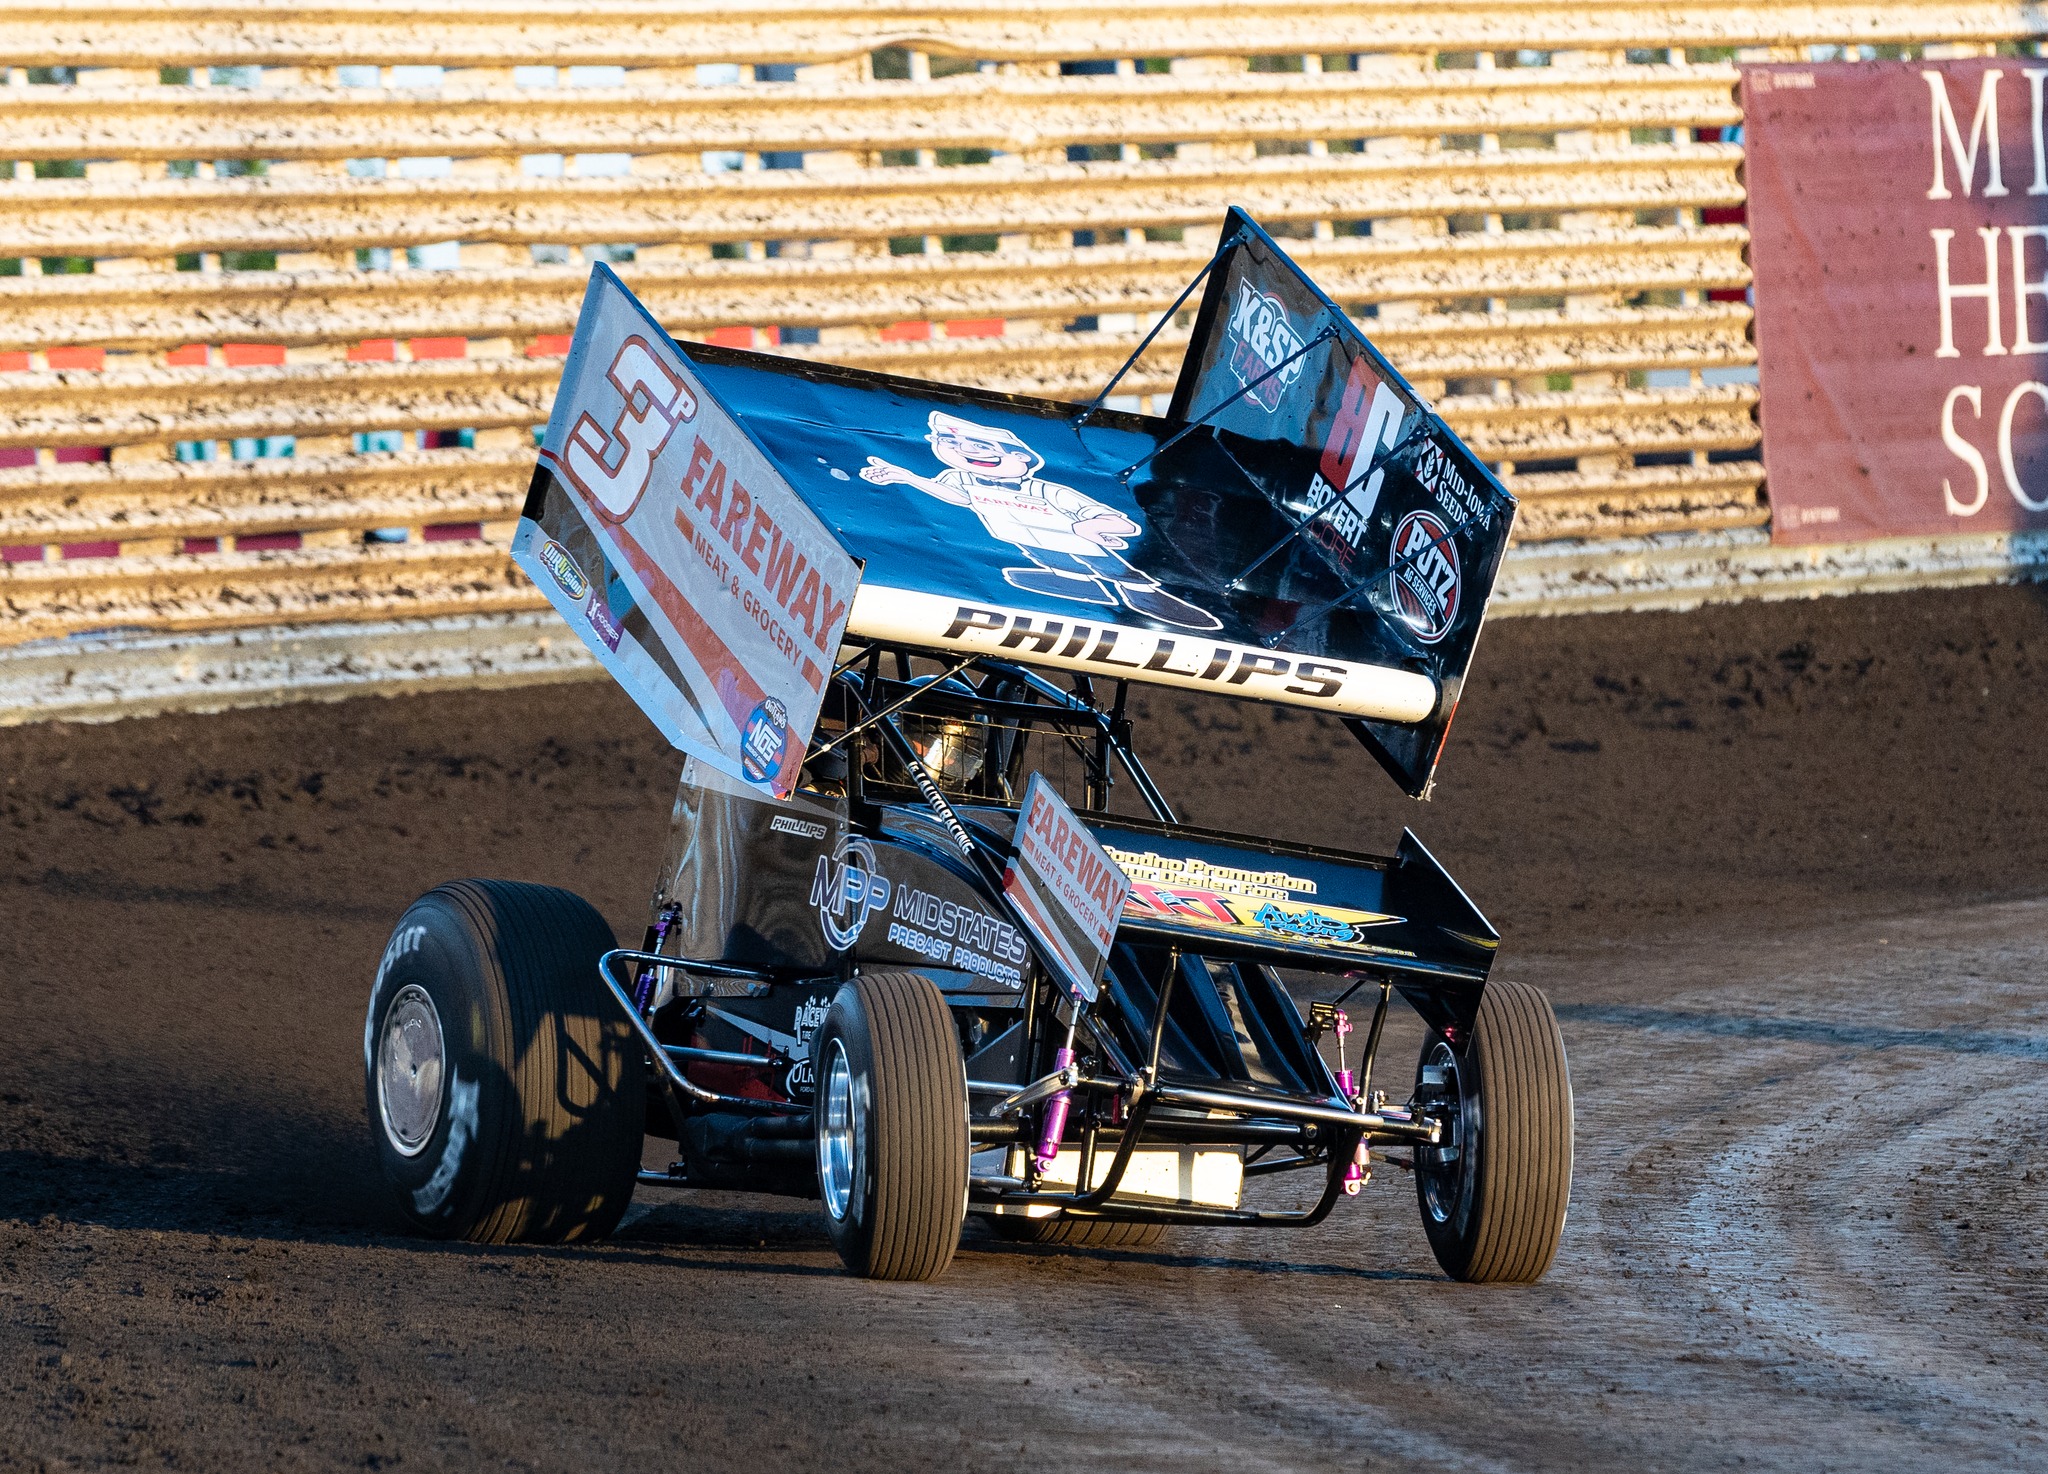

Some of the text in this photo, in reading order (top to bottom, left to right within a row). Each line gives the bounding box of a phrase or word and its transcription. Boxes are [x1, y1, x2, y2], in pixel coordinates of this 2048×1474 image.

[975, 495, 1049, 513] FAREWAY
[681, 434, 845, 654] FAREWAY
[1403, 517, 1456, 612] PUTZ
[695, 533, 729, 583] MEAT
[731, 575, 740, 599] &
[743, 590, 802, 667] GROCERY
[1403, 567, 1437, 616] AG SERVICES
[597, 611, 619, 642] HOOSIER
[942, 606, 1348, 698] PHILLIPS
[749, 718, 782, 762] NOS
[771, 817, 826, 838] PHILLIPS
[940, 808, 975, 856] RACING
[1028, 788, 1125, 923] FAREWAY
[810, 855, 891, 925] MPP
[1034, 848, 1099, 931] MEAT & GROCERY
[1160, 871, 1238, 892] Dealer
[1188, 859, 1314, 892] Promotion
[888, 923, 1022, 990] PRECAST PRODUCTS
[893, 885, 1027, 964] MIDSTATES
